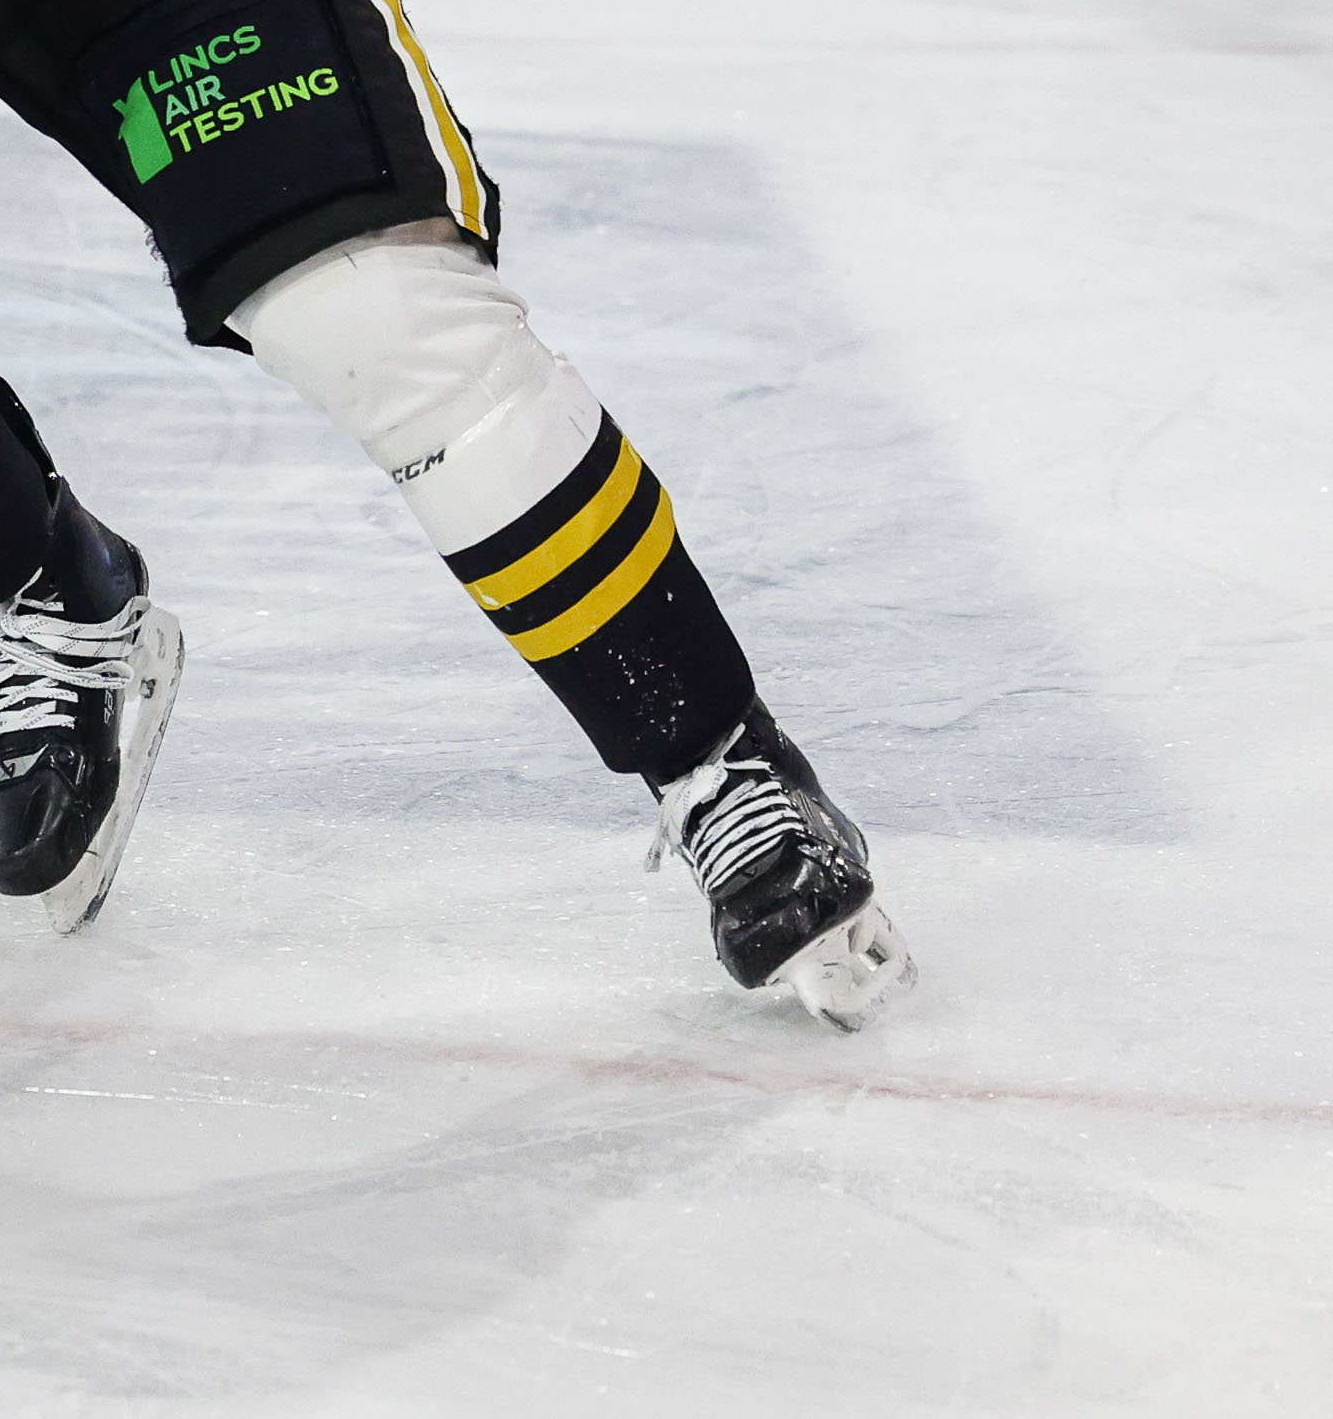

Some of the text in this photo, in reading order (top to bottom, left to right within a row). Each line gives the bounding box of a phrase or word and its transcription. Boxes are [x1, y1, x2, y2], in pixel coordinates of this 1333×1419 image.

[149, 24, 261, 95] LINCS
[163, 73, 224, 125] AIR
[170, 68, 339, 153] TESTING
[392, 448, 446, 484] CCM
